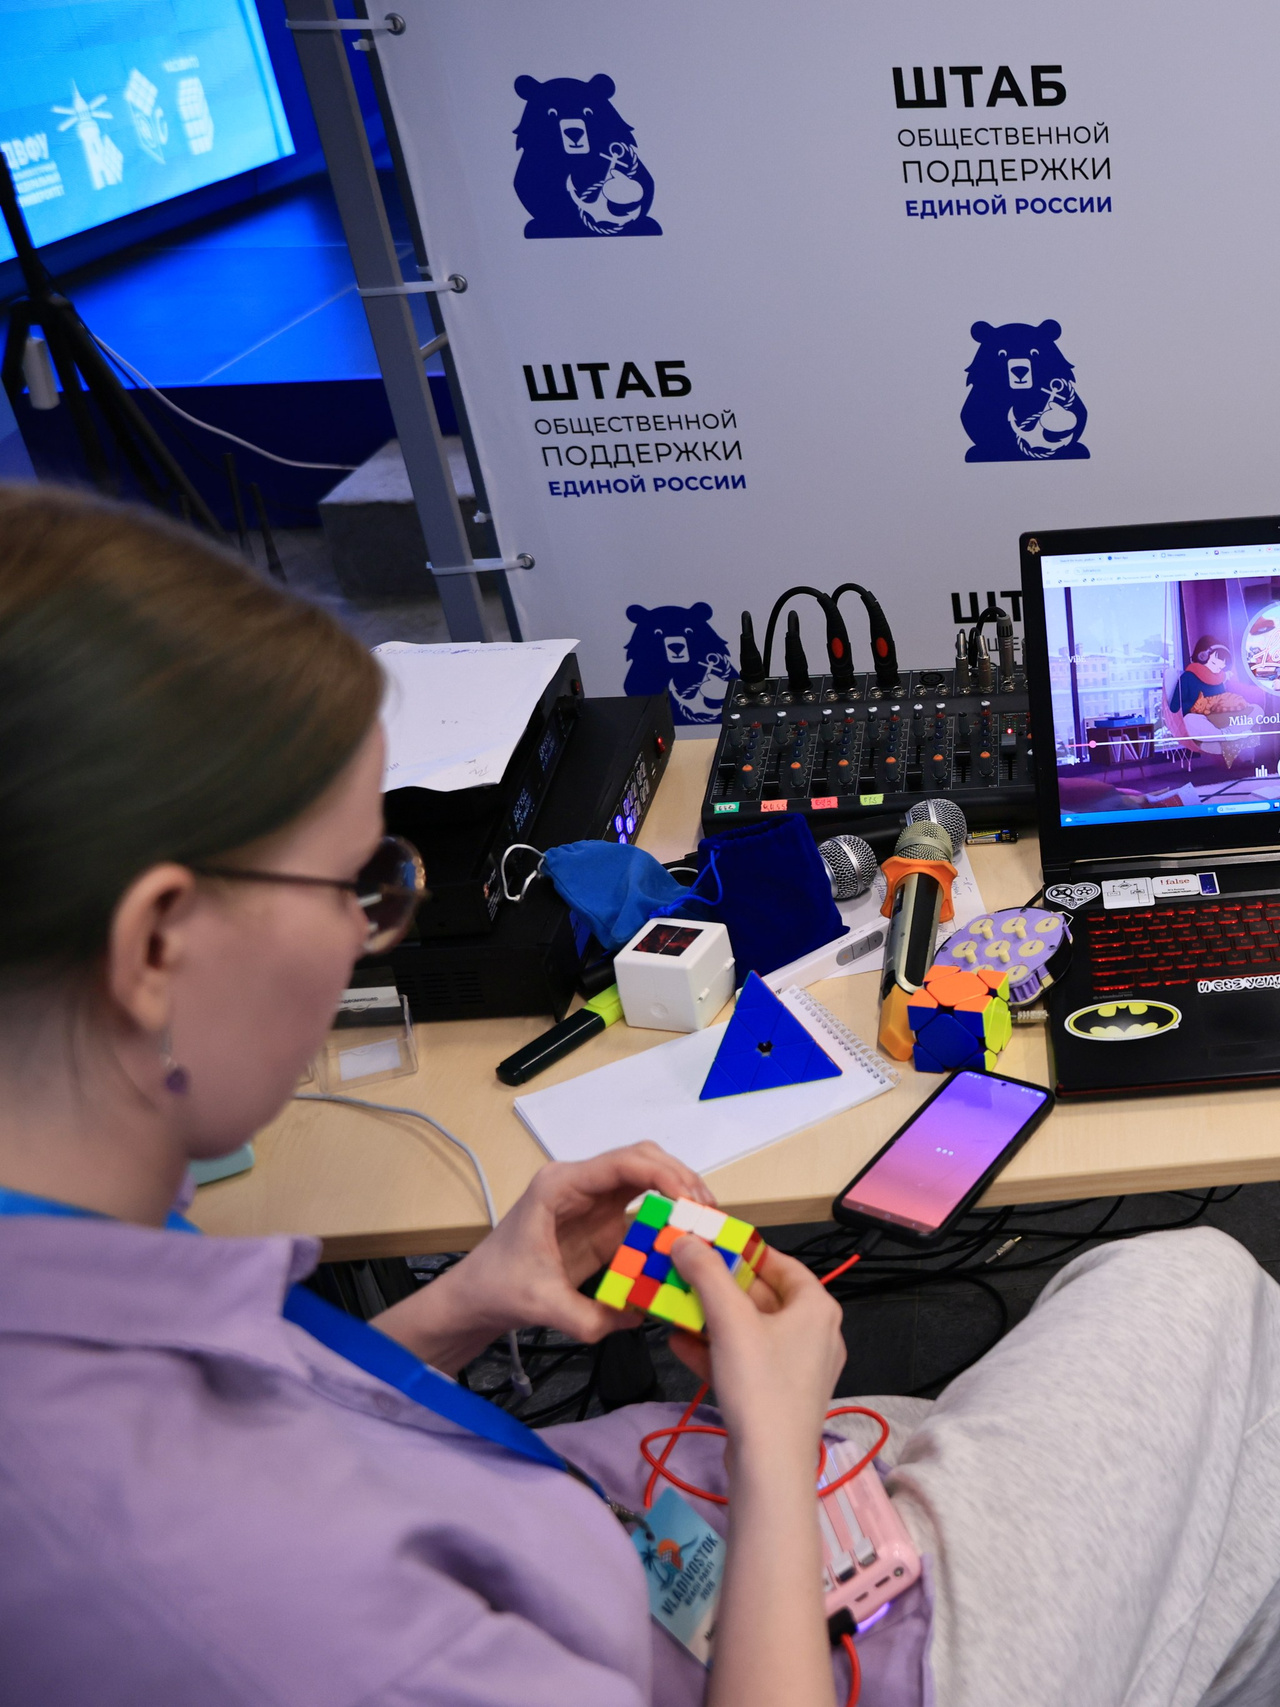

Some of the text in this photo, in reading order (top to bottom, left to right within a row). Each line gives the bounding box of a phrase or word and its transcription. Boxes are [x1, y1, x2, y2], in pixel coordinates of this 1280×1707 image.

[892, 65, 1066, 108] ШТАБ
[898, 122, 1108, 149] ОБЩЕСТВЕННОЙ
[903, 157, 1110, 187] ПОДДЕРЖКИ
[906, 195, 1111, 219] ЕДИНОЙ РОССИИ
[523, 360, 691, 401] ШТАБ
[535, 410, 736, 436] ОБЩЕСТВЕННОЙ
[542, 441, 742, 469] ПОДДЕРЖКИ
[549, 475, 746, 498] ЕДИНОЙ РОССИИ
[1229, 715, 1253, 726] Mila
[661, 1533, 718, 1616] VLADIVOSTOK
[698, 1559, 715, 1583] PARTY
[700, 1580, 716, 1600] 2026
